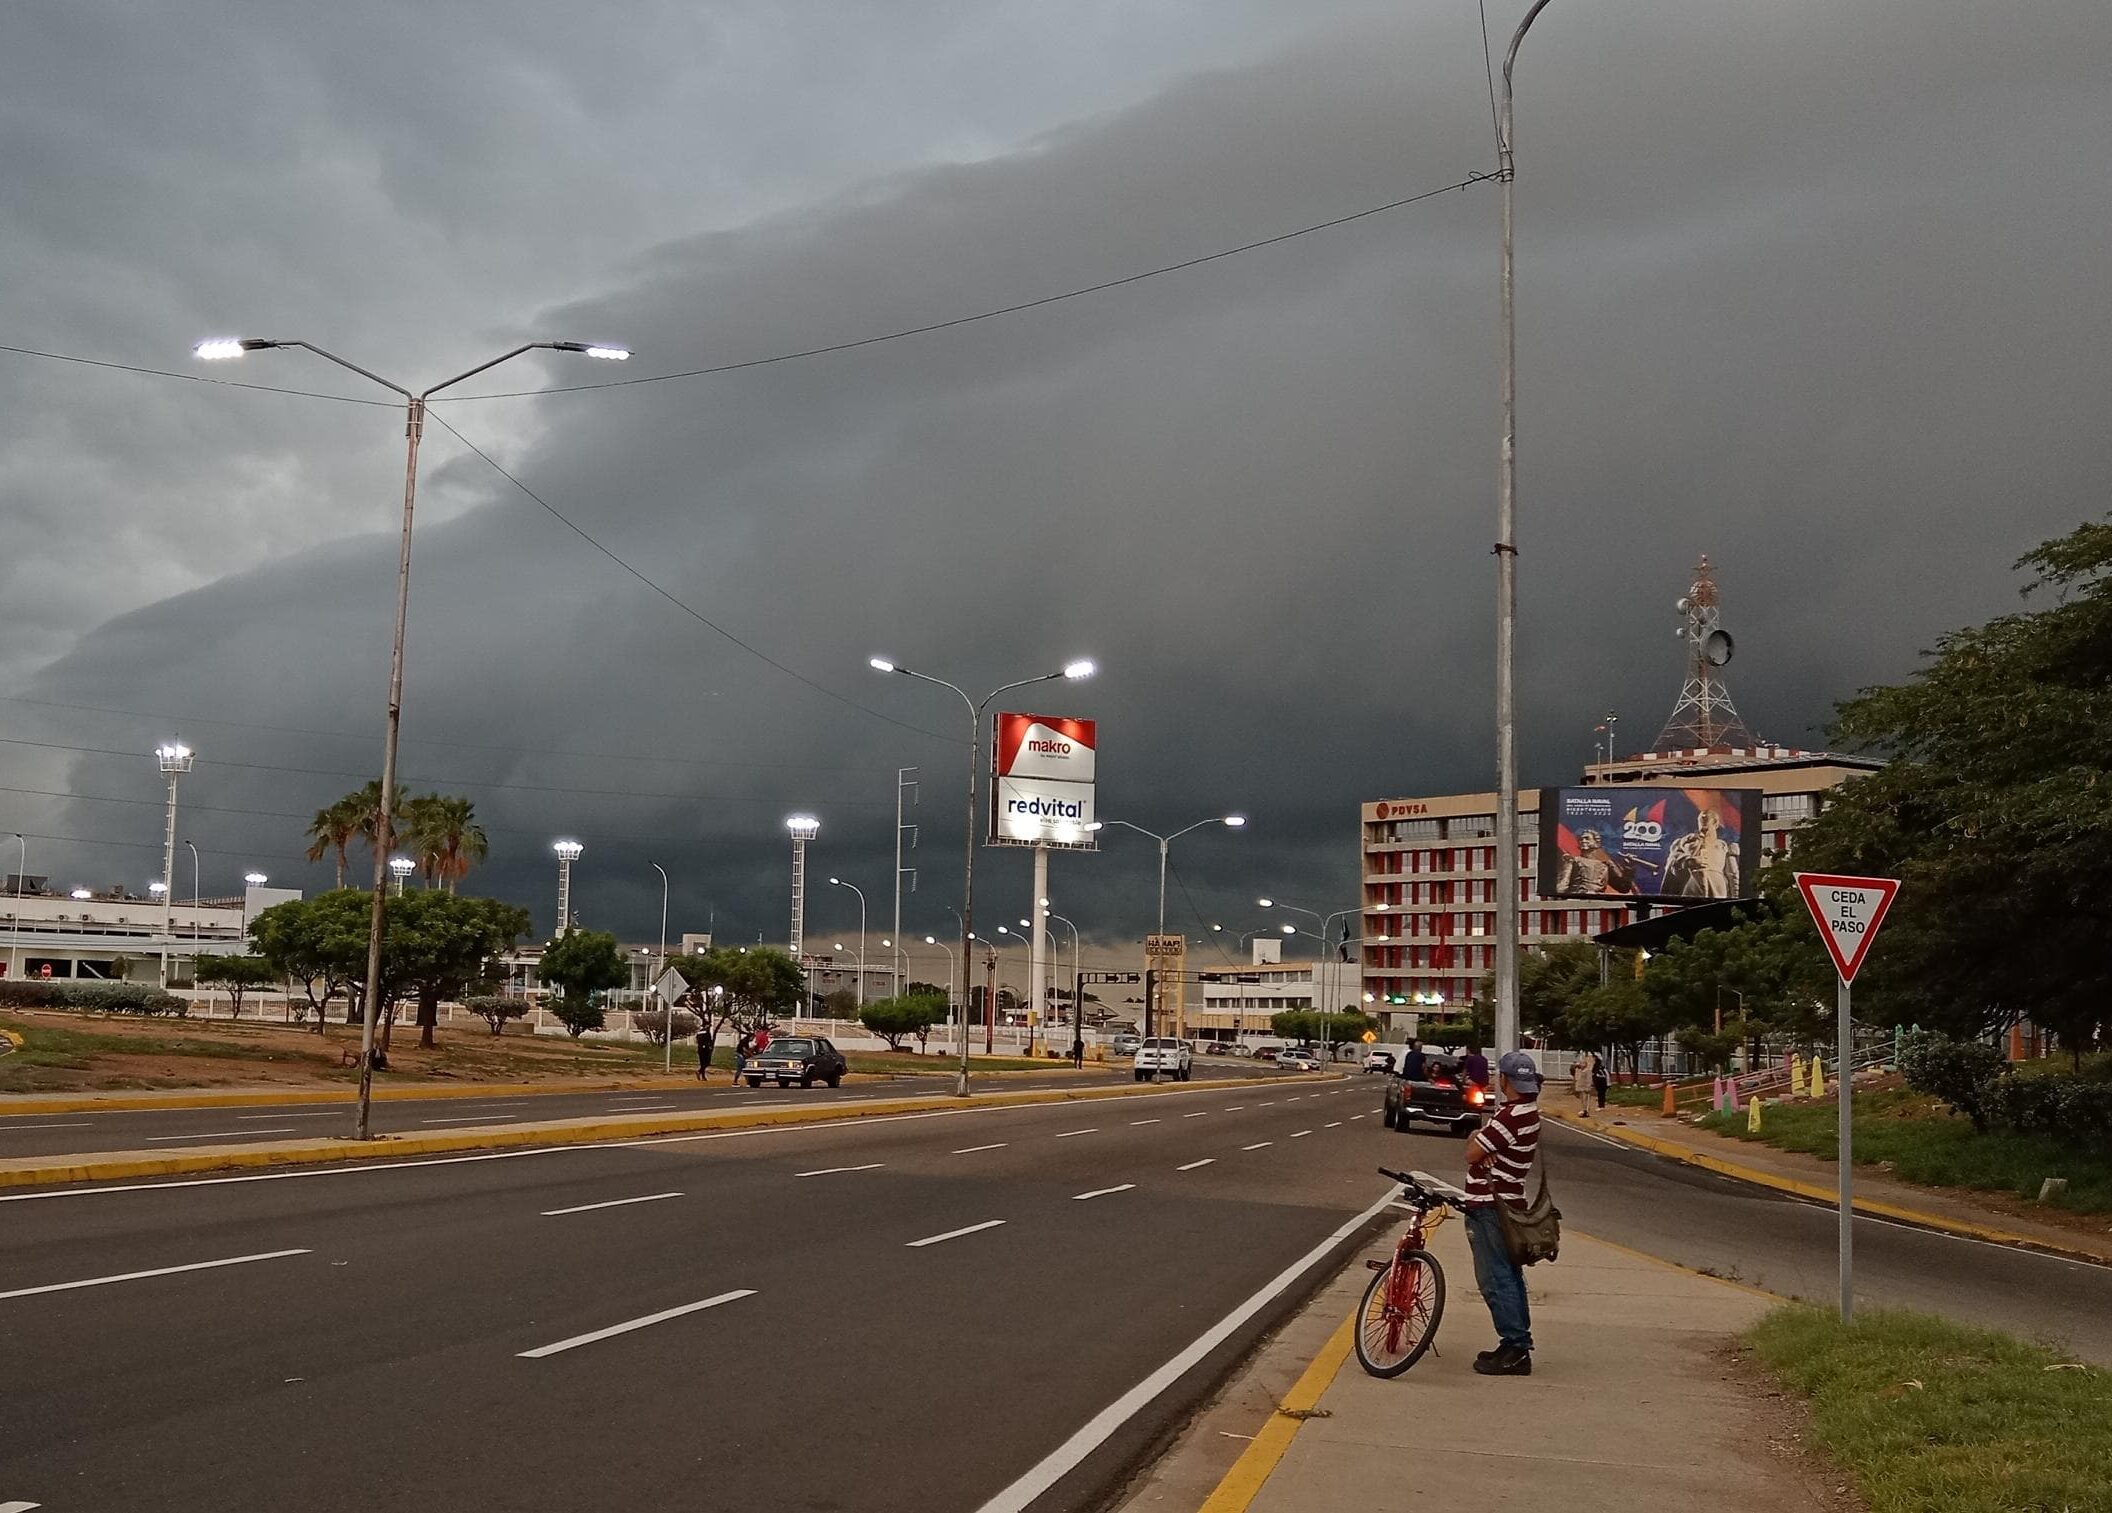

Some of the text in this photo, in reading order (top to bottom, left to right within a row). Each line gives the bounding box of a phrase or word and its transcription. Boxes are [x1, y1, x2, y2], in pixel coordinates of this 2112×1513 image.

[1028, 740, 1071, 754] makro
[1008, 797, 1081, 818] redvital
[1392, 804, 1428, 816] PDVSA
[1623, 821, 1662, 842] 200
[1831, 891, 1866, 904] CEDA
[1841, 906, 1856, 918] EL
[1832, 920, 1865, 933] PASO
